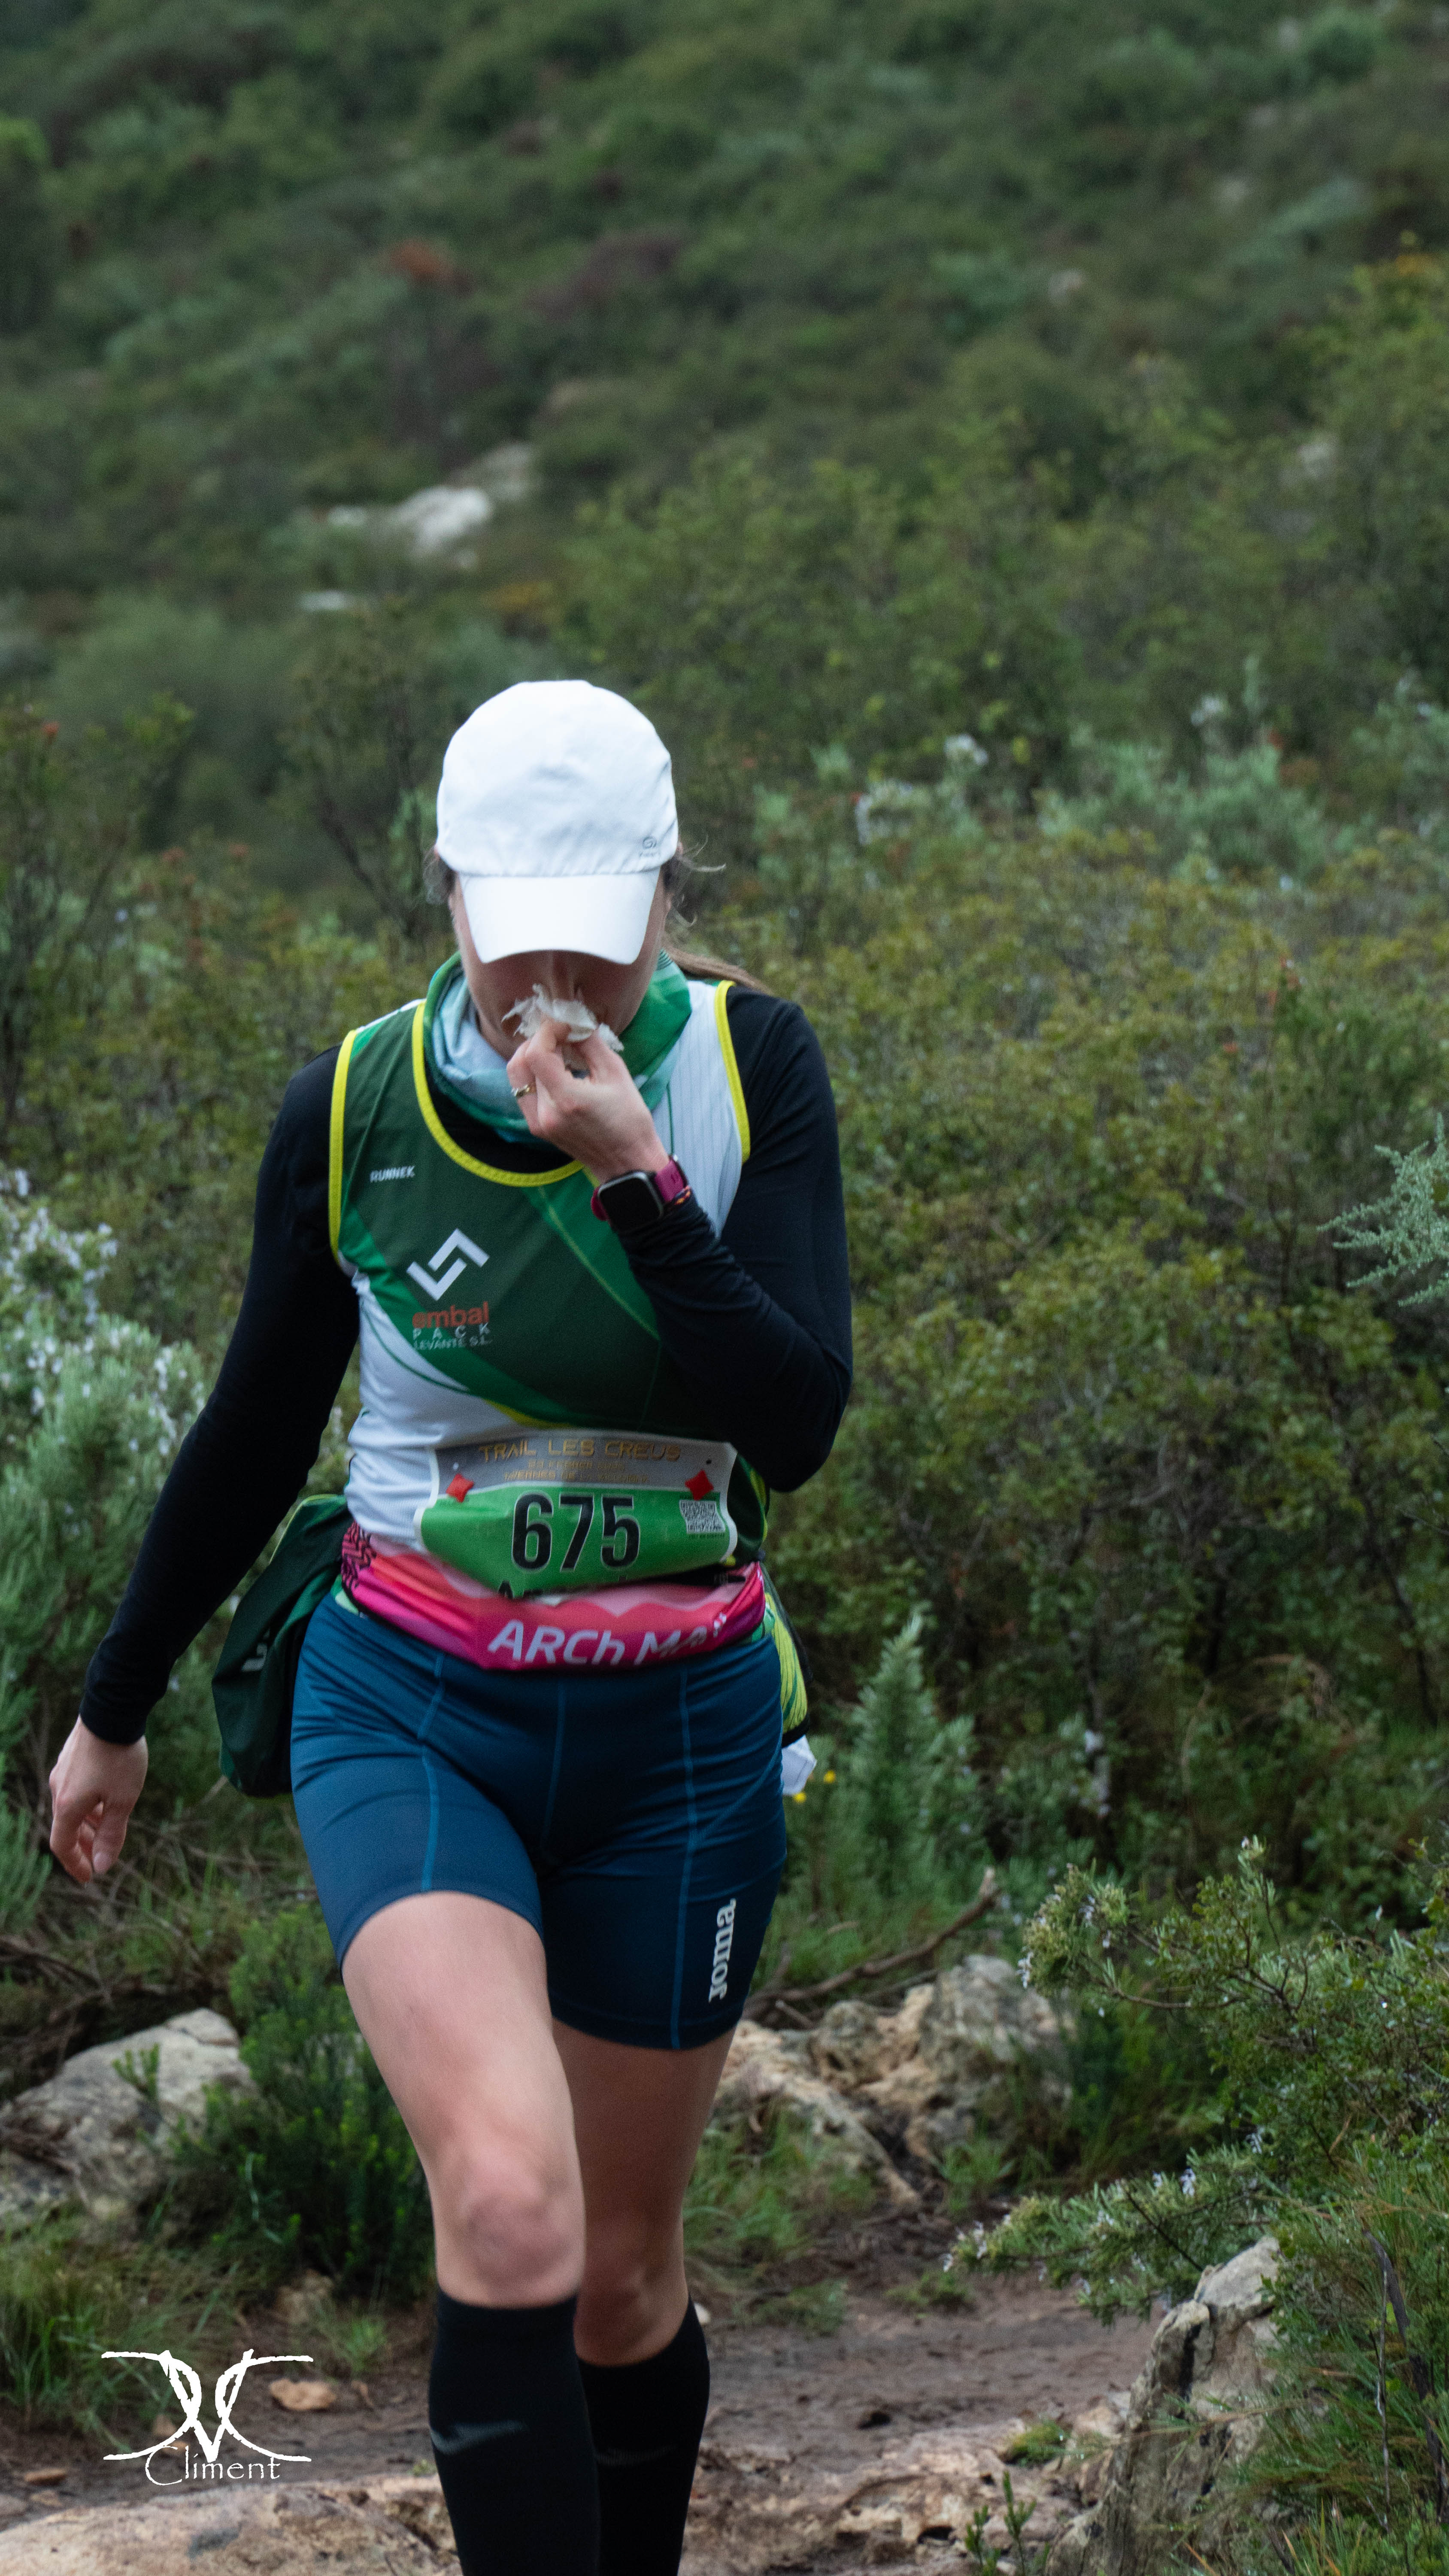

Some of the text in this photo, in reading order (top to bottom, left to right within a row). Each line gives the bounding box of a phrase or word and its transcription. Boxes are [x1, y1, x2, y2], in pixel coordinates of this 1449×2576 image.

[412, 1301, 489, 1329] embal
[479, 1439, 681, 1462] TRAIL LES CREUS
[512, 1492, 640, 1573] 675
